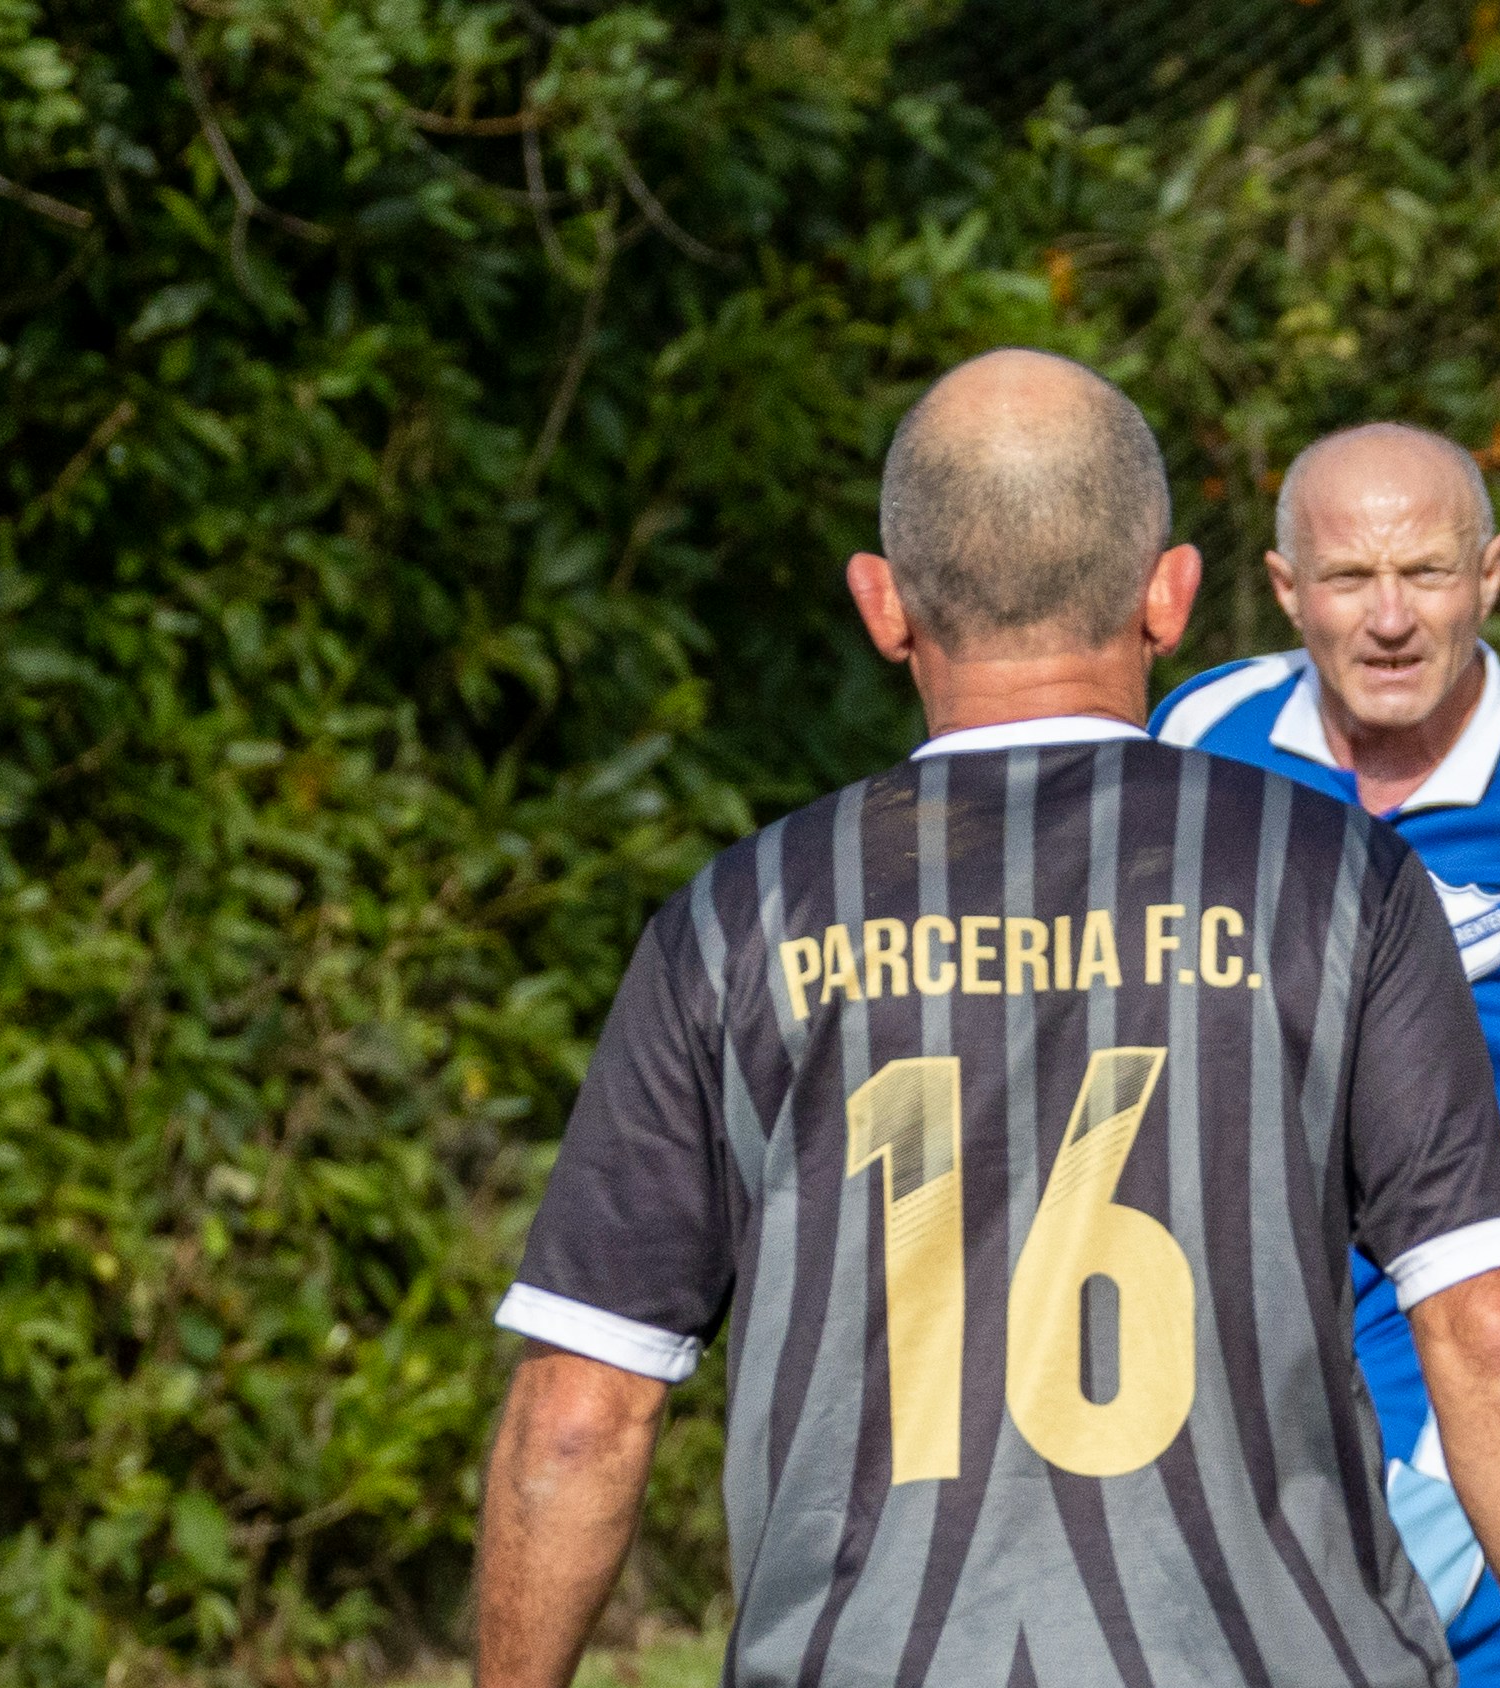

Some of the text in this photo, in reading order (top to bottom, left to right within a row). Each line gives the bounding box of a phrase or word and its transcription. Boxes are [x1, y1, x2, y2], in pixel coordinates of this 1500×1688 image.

[778, 904, 1263, 1021] PARCERIA F.C.
[846, 1046, 1198, 1485] 16
